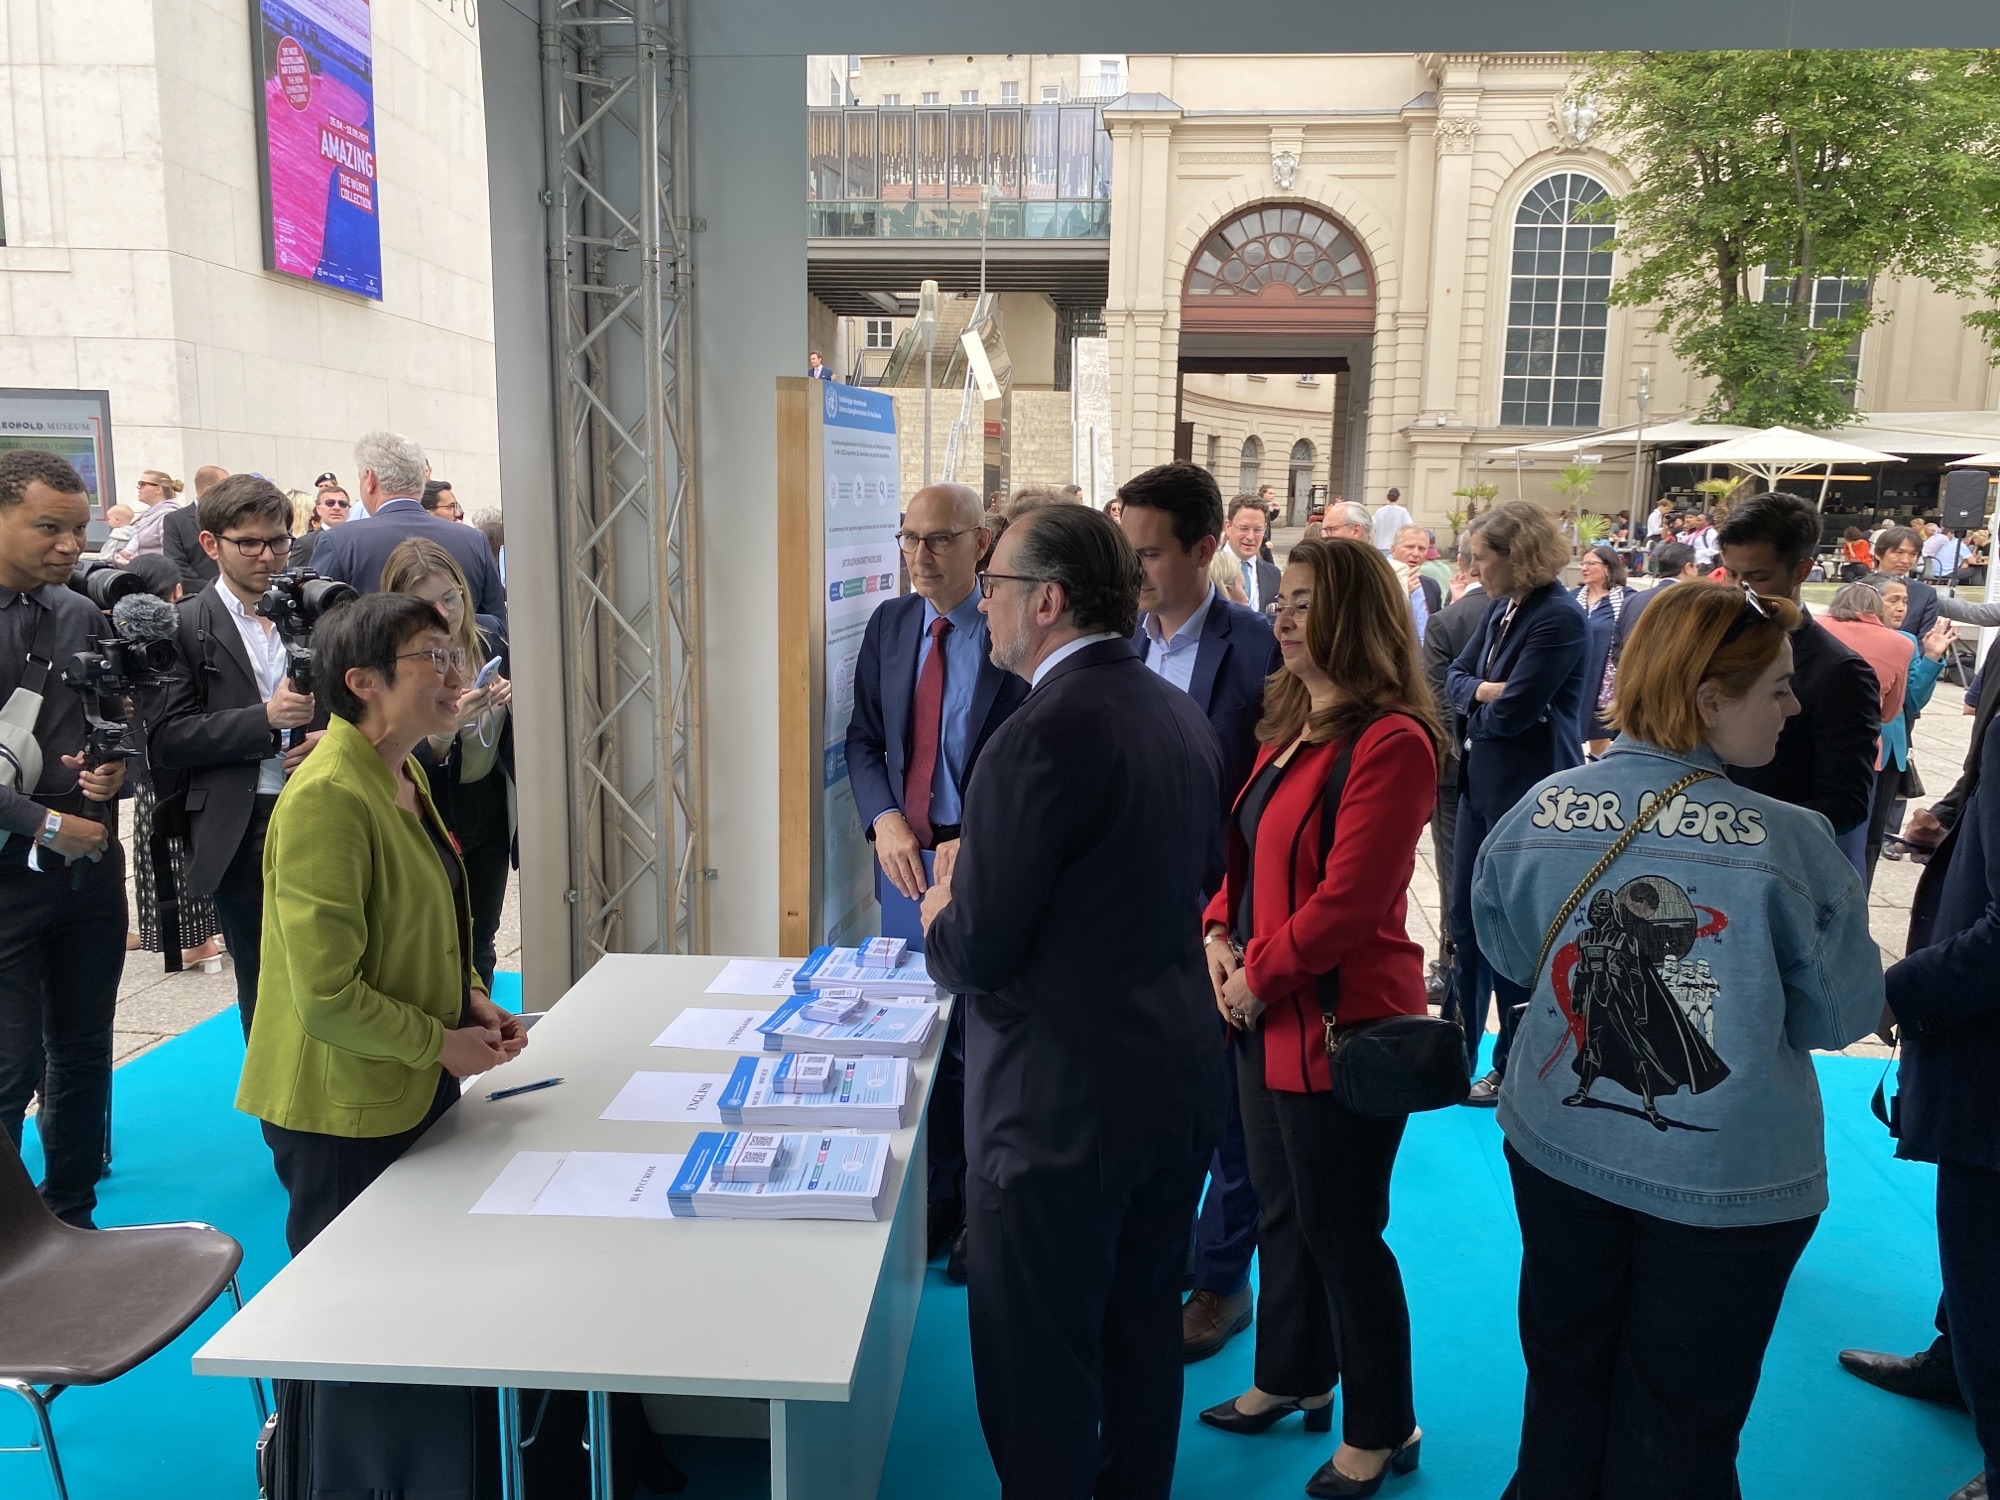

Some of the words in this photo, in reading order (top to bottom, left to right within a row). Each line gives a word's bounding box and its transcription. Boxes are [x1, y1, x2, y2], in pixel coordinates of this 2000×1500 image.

[320, 129, 374, 179] AMAZING
[339, 173, 351, 188] THE
[351, 177, 370, 196] WÜRTH
[340, 188, 372, 210] COLLECTION
[0, 421, 43, 431] EOPOLD
[46, 422, 90, 431] MUSEUM
[686, 1082, 713, 1110] ENGLISH
